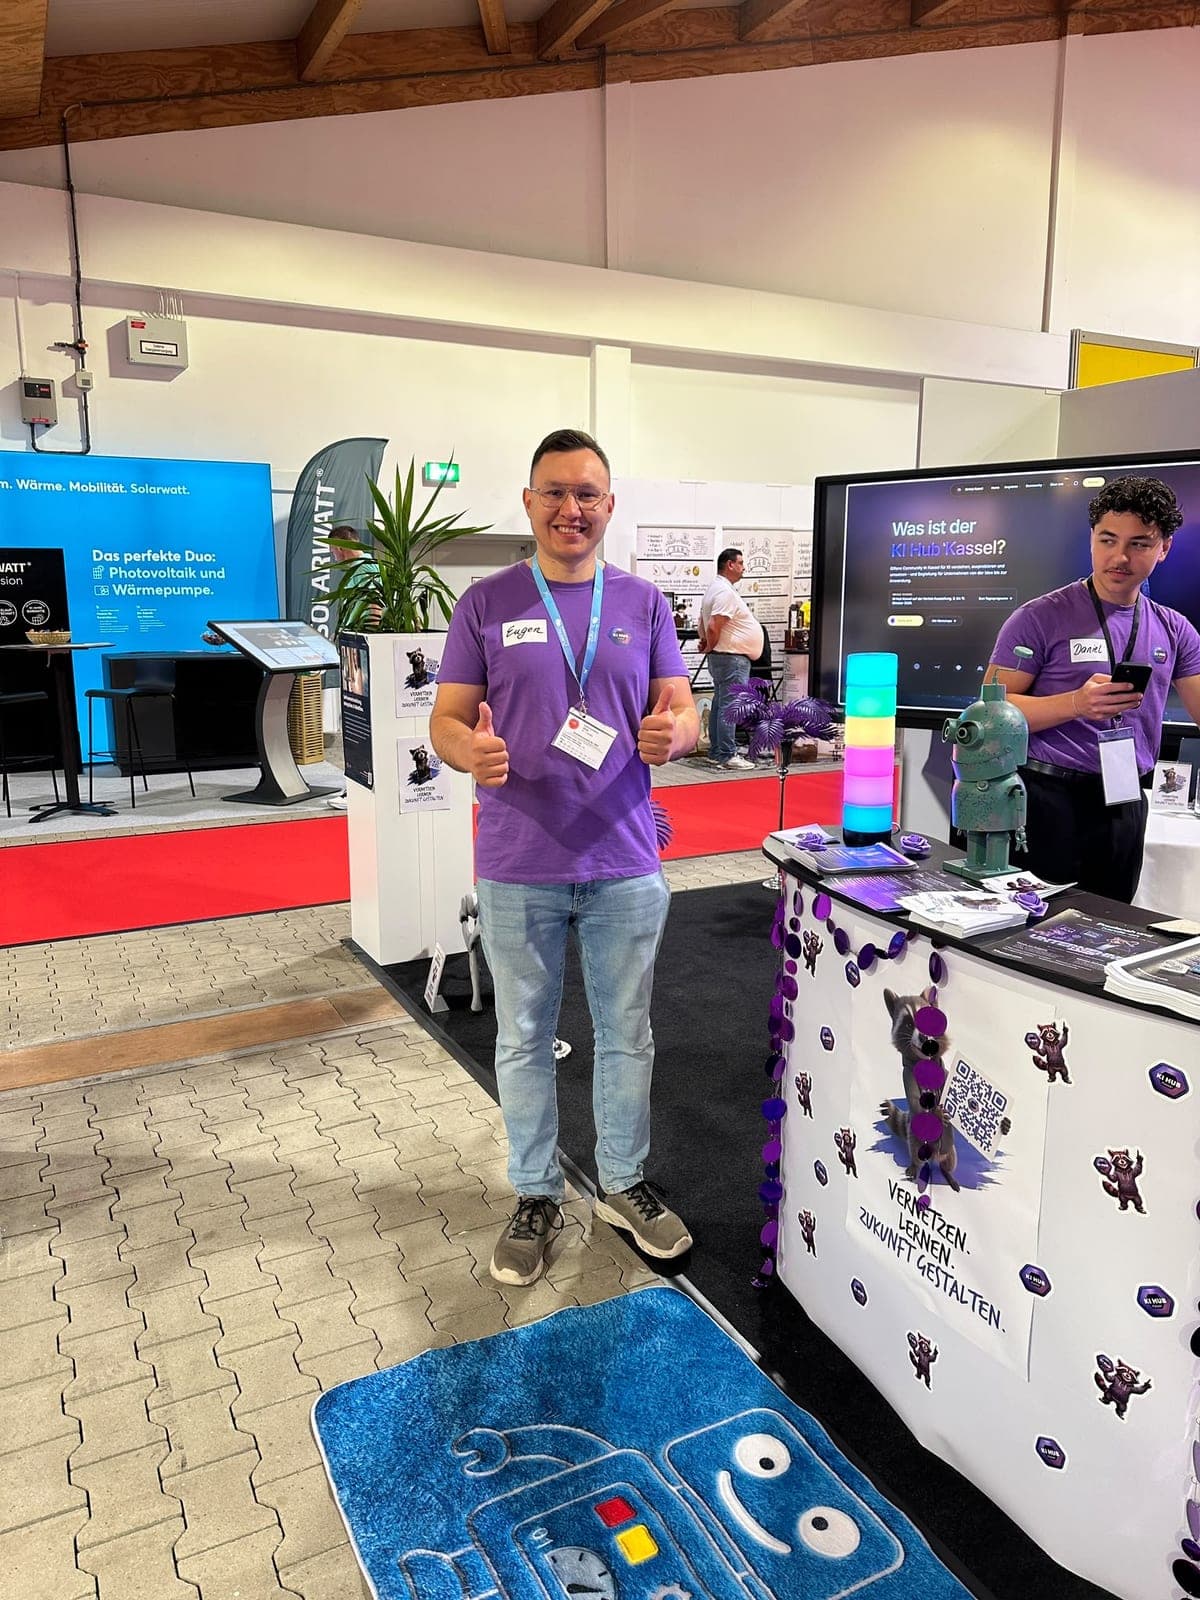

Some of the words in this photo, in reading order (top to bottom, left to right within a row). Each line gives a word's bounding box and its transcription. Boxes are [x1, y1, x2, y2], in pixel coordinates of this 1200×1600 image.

[16, 478, 66, 492] Wärme.
[69, 481, 128, 494] Mobilität.
[130, 483, 190, 495] Solarwatt.
[892, 521, 925, 537] Was
[928, 520, 947, 535] ist
[949, 519, 977, 534] der
[92, 550, 120, 562] Das
[124, 550, 181, 564] perfekte
[185, 551, 217, 563] Duo:
[891, 543, 906, 558] KI
[910, 542, 940, 557] Hub
[944, 539, 1006, 556] Kassel?
[109, 566, 196, 580] Photovoltaik
[200, 567, 225, 580] und
[112, 583, 214, 598] Wärmepumpe.
[506, 624, 544, 640] Eugen
[1073, 643, 1103, 656] Daniel
[1156, 1072, 1165, 1081] KI
[1165, 1076, 1181, 1089] HUB
[888, 1178, 971, 1255] VERNETZEN.
[899, 1212, 955, 1269] LERNEN.
[859, 1206, 917, 1263] ZUKUNFT
[916, 1254, 1006, 1333] GESTALTEN.
[1143, 1296, 1152, 1305] KI
[1152, 1297, 1167, 1305] HUB
